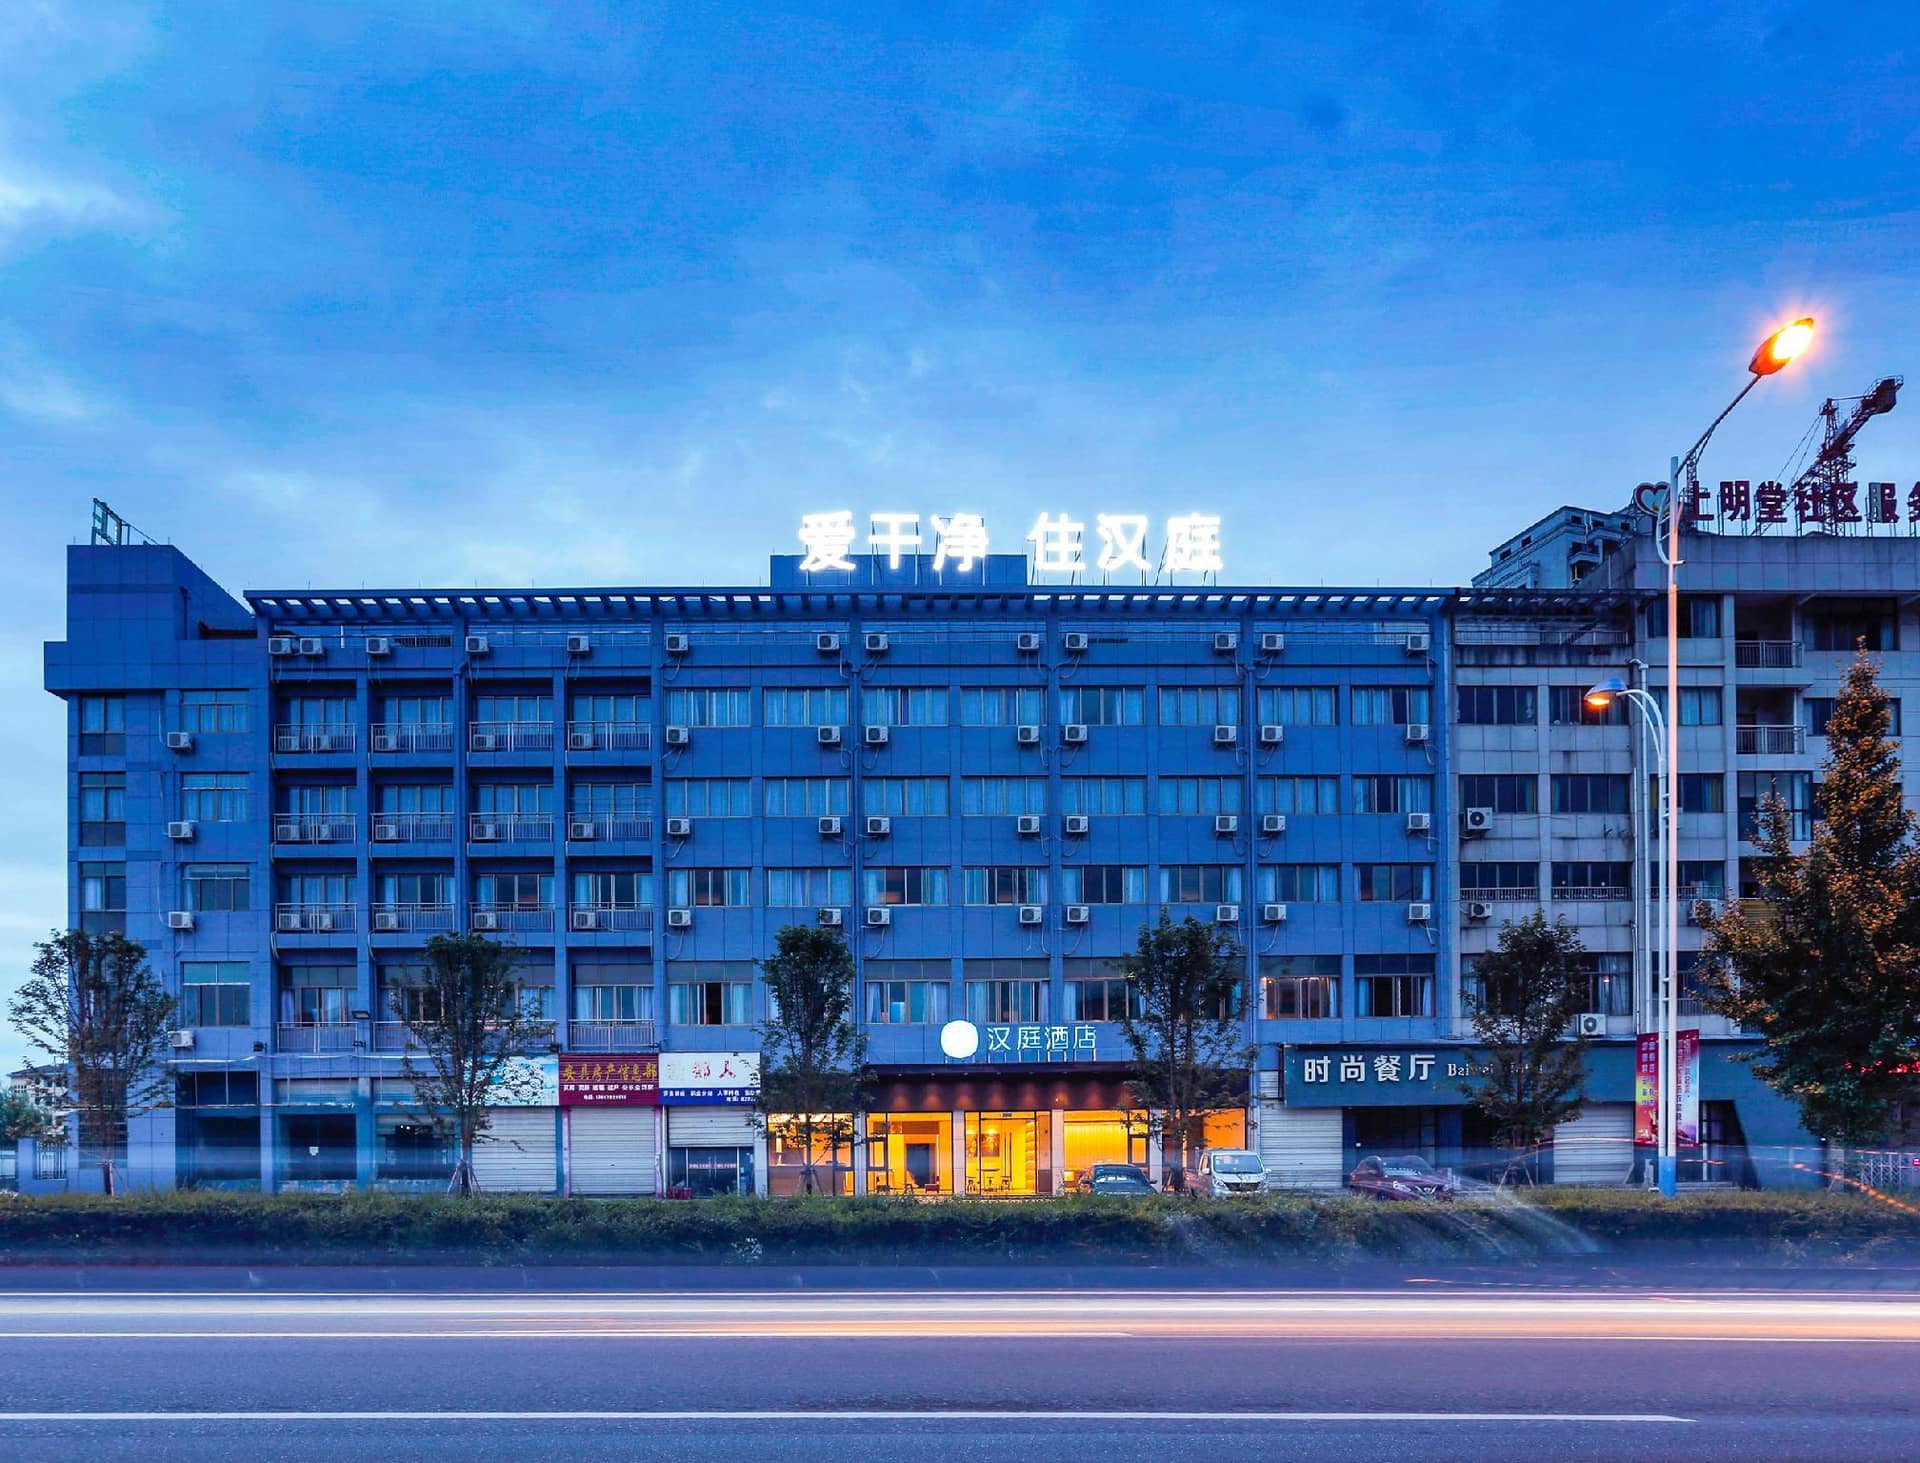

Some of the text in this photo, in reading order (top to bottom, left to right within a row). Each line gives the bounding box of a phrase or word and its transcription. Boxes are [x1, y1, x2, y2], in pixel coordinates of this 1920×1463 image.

[798, 511, 1223, 572] 爱干净 住汉庭
[987, 1024, 1097, 1051] 汉庭酒店
[1304, 1054, 1436, 1083] 时尚餐厅
